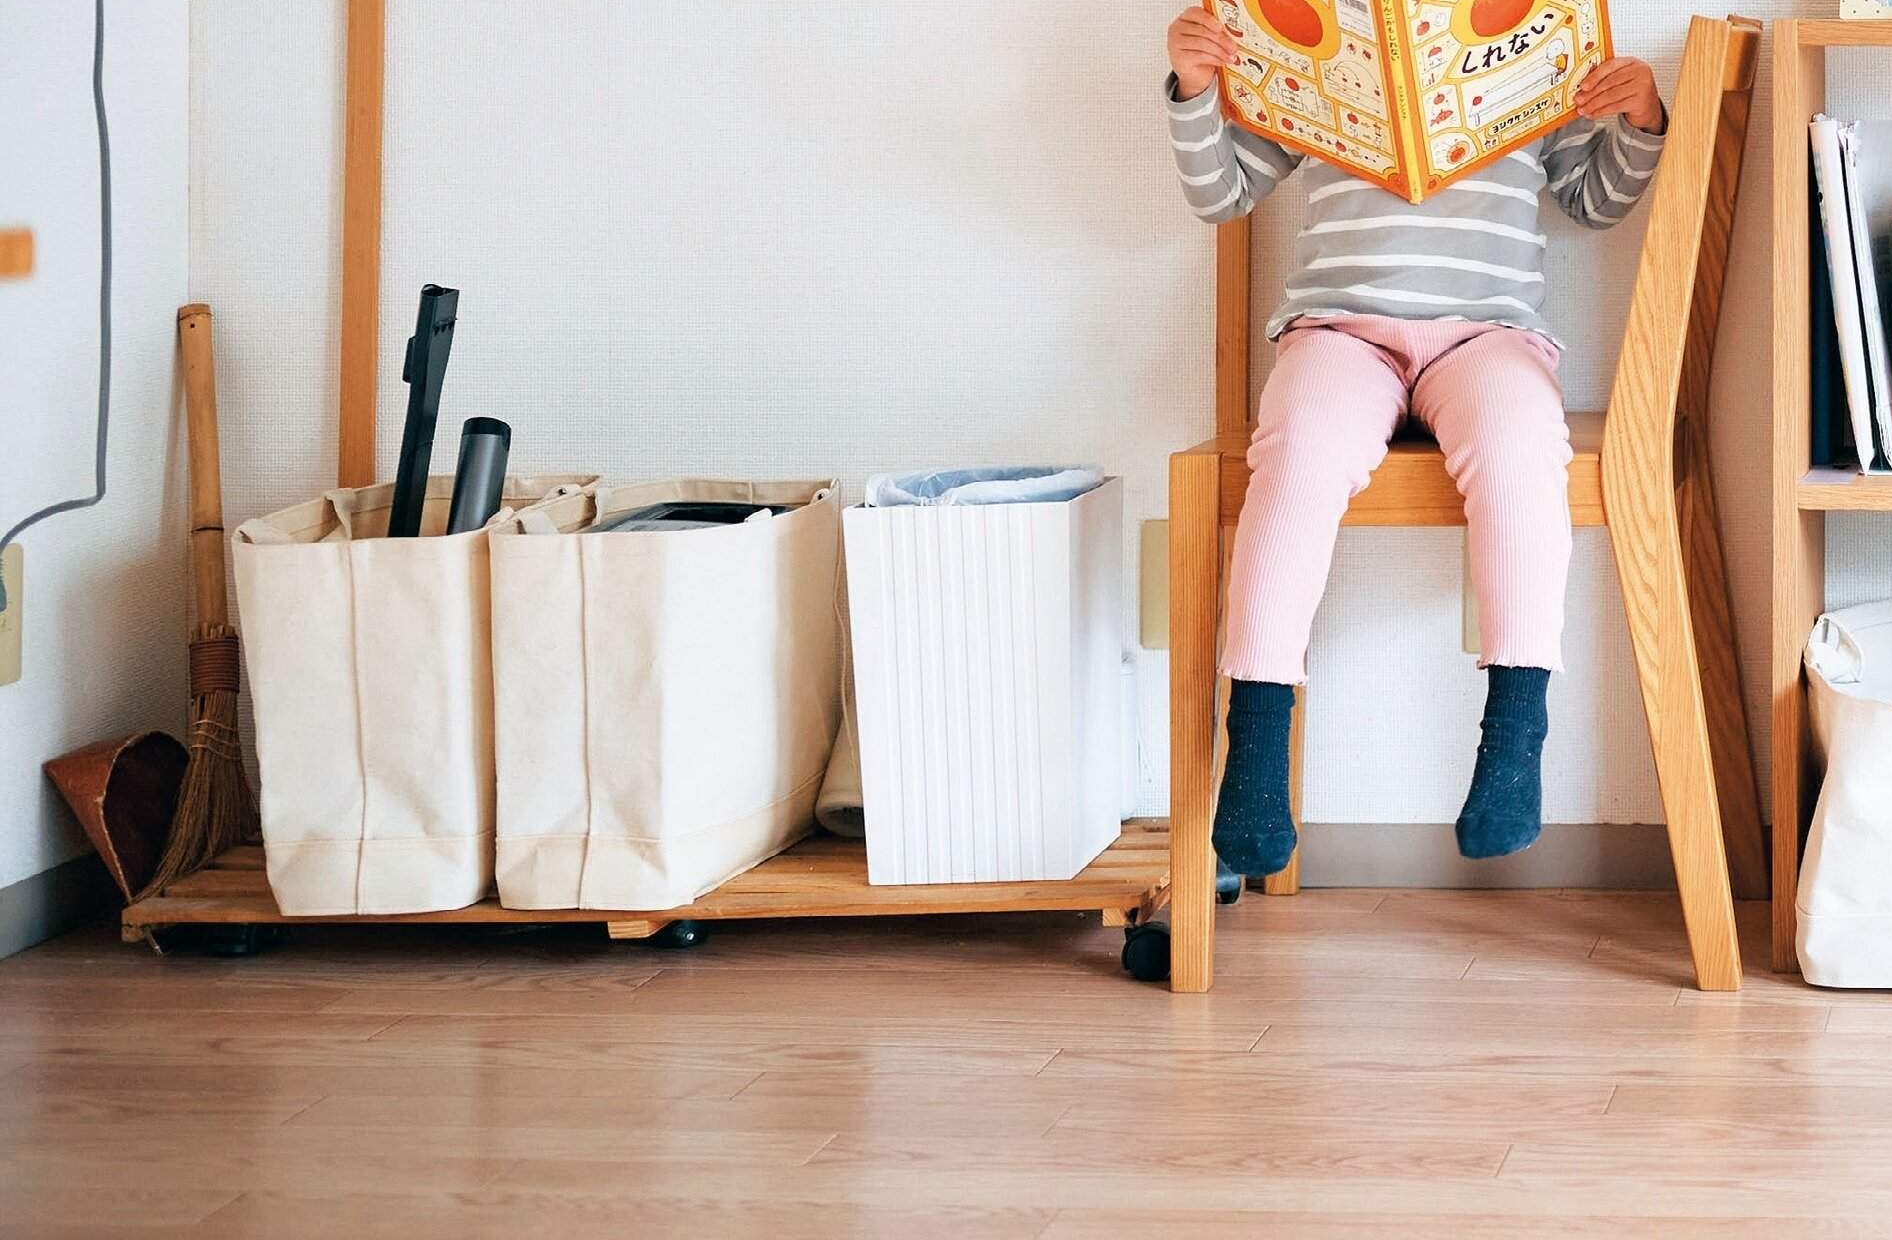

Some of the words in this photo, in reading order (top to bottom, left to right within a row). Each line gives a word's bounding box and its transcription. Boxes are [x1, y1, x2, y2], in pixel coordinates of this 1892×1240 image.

[1462, 12, 1554, 75] しれない
[1491, 99, 1549, 134] ヨシタケシンスケ
